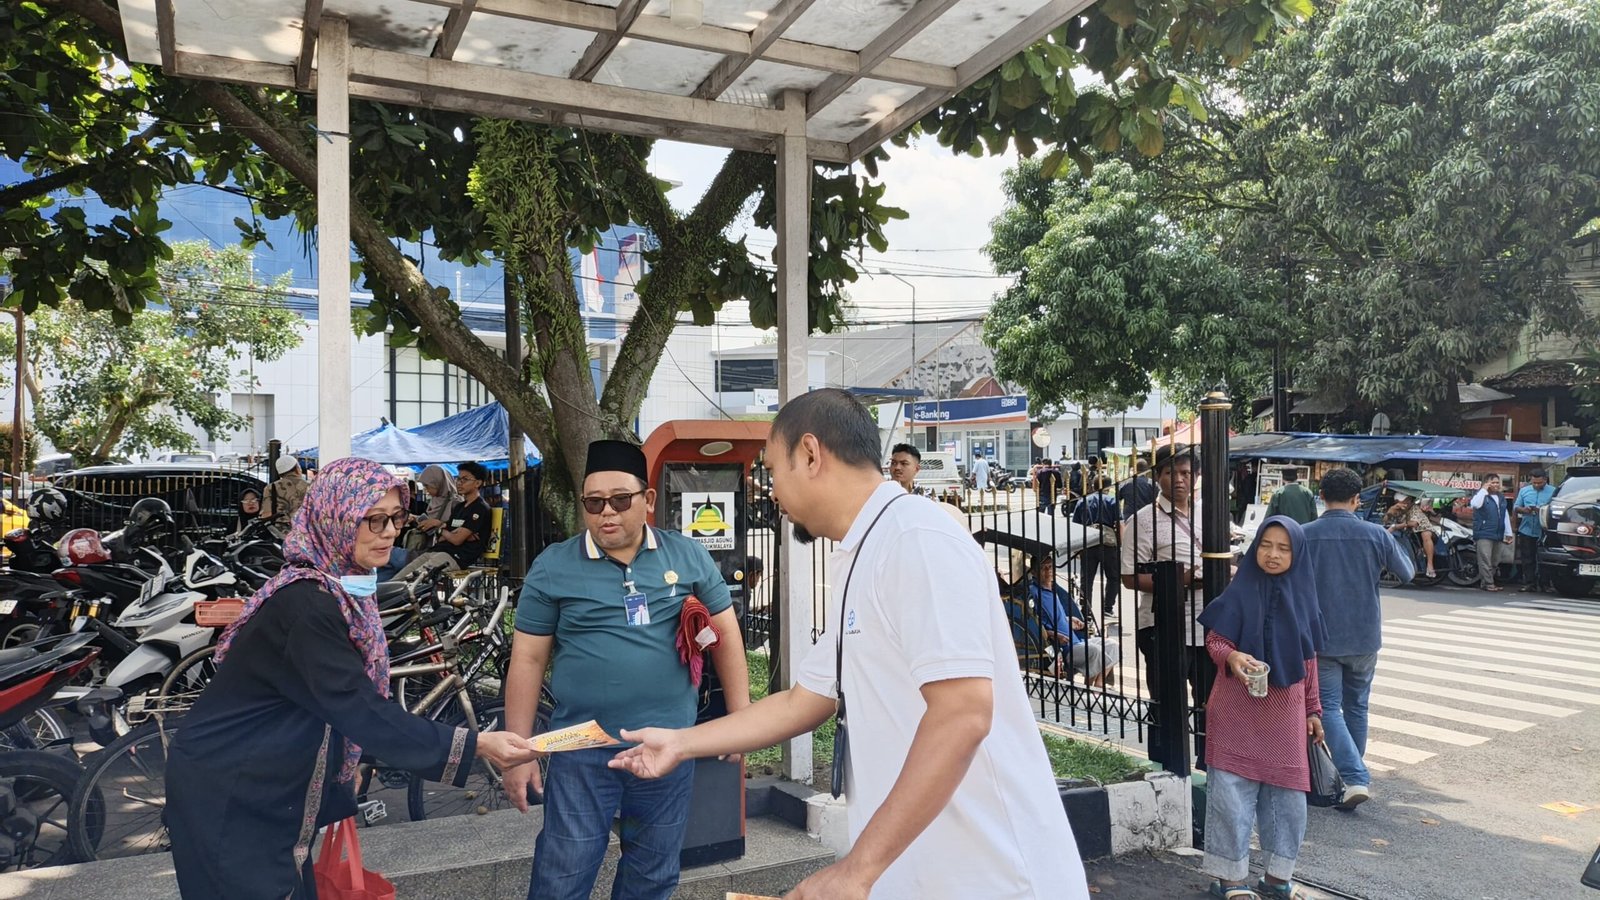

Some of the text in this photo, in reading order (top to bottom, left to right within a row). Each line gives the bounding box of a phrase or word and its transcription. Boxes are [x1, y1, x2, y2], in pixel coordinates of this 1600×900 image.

[914, 410, 950, 420] e-Bankng
[1451, 480, 1482, 489] TAHU
[181, 629, 205, 639] HONDA
